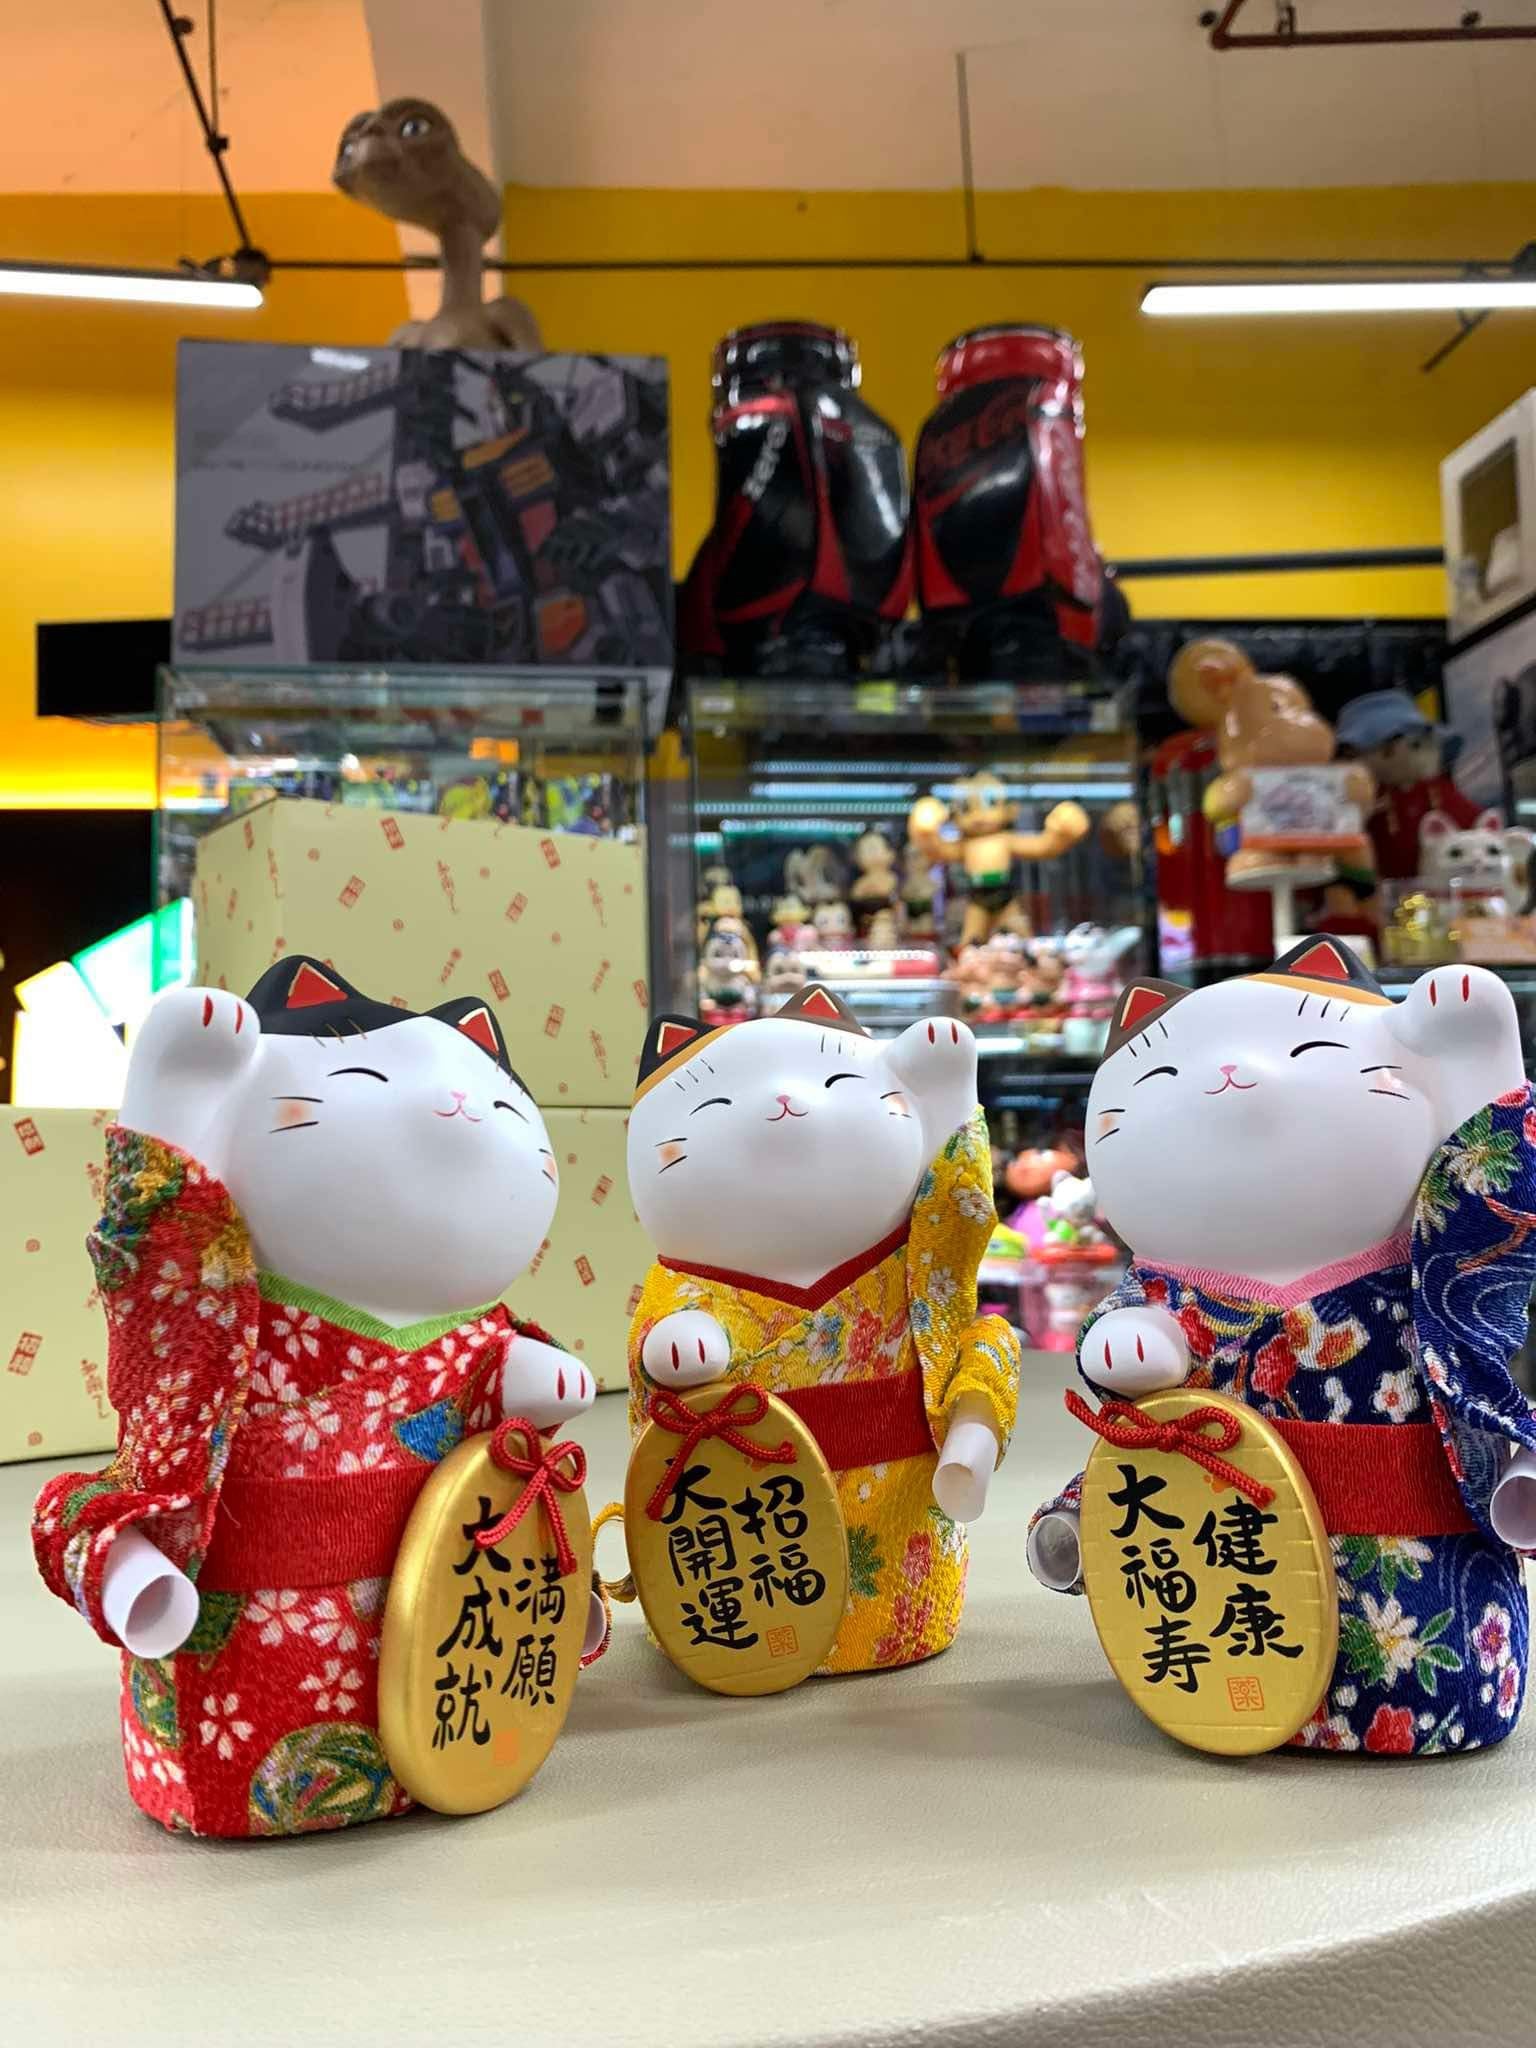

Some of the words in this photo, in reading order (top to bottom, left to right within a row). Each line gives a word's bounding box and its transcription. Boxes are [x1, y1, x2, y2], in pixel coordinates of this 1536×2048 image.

[433, 1497, 512, 1749] 大成就
[657, 1457, 759, 1650] 大開運
[731, 1475, 826, 1607] 招福
[1108, 1464, 1211, 1693] 大福寿
[1193, 1496, 1304, 1658] 健康
